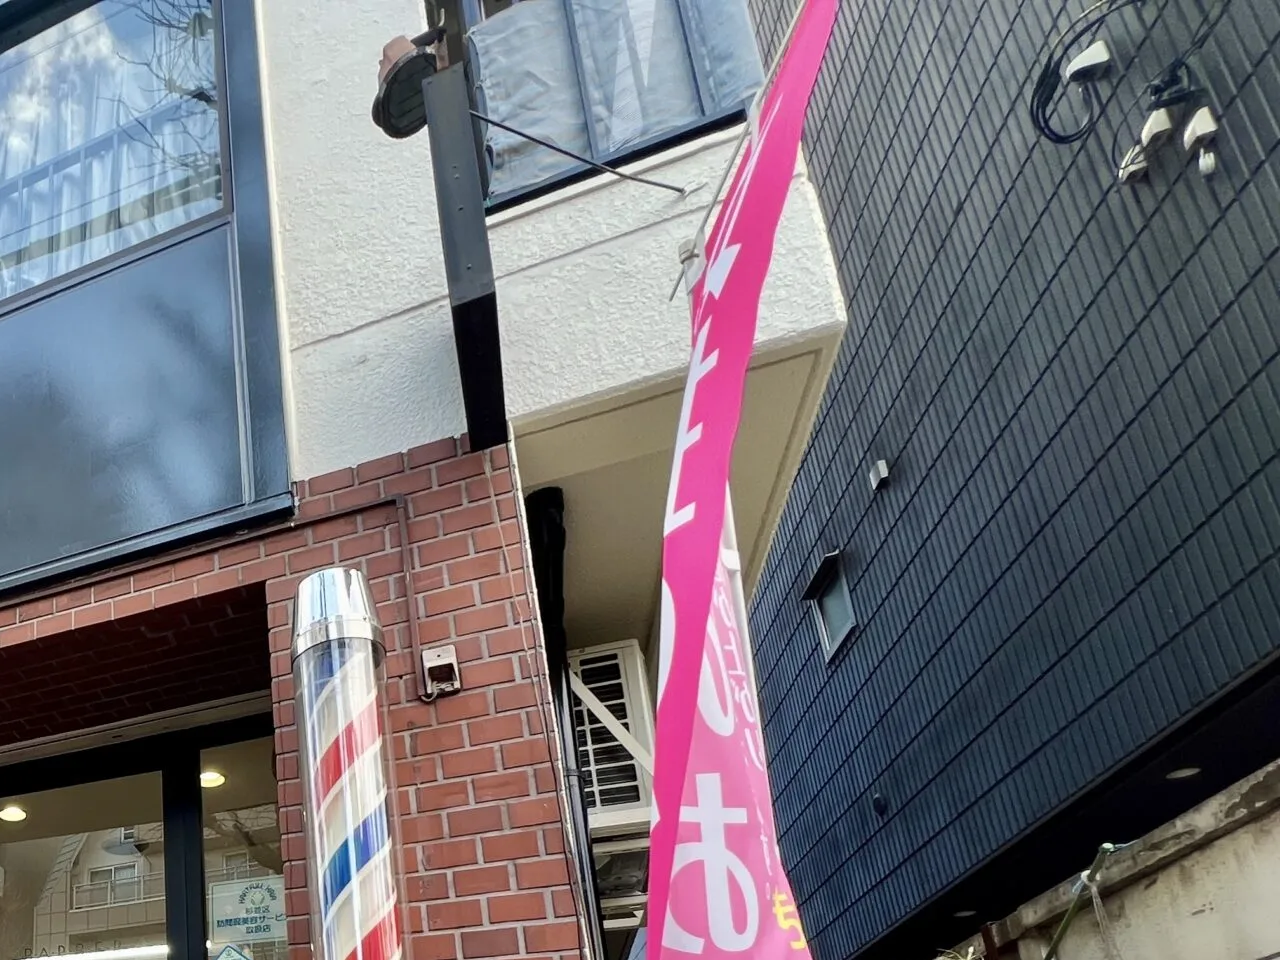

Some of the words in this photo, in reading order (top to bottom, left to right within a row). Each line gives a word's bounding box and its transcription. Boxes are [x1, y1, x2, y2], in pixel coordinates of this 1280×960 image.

[216, 912, 287, 929] 訪問理美容サービ
